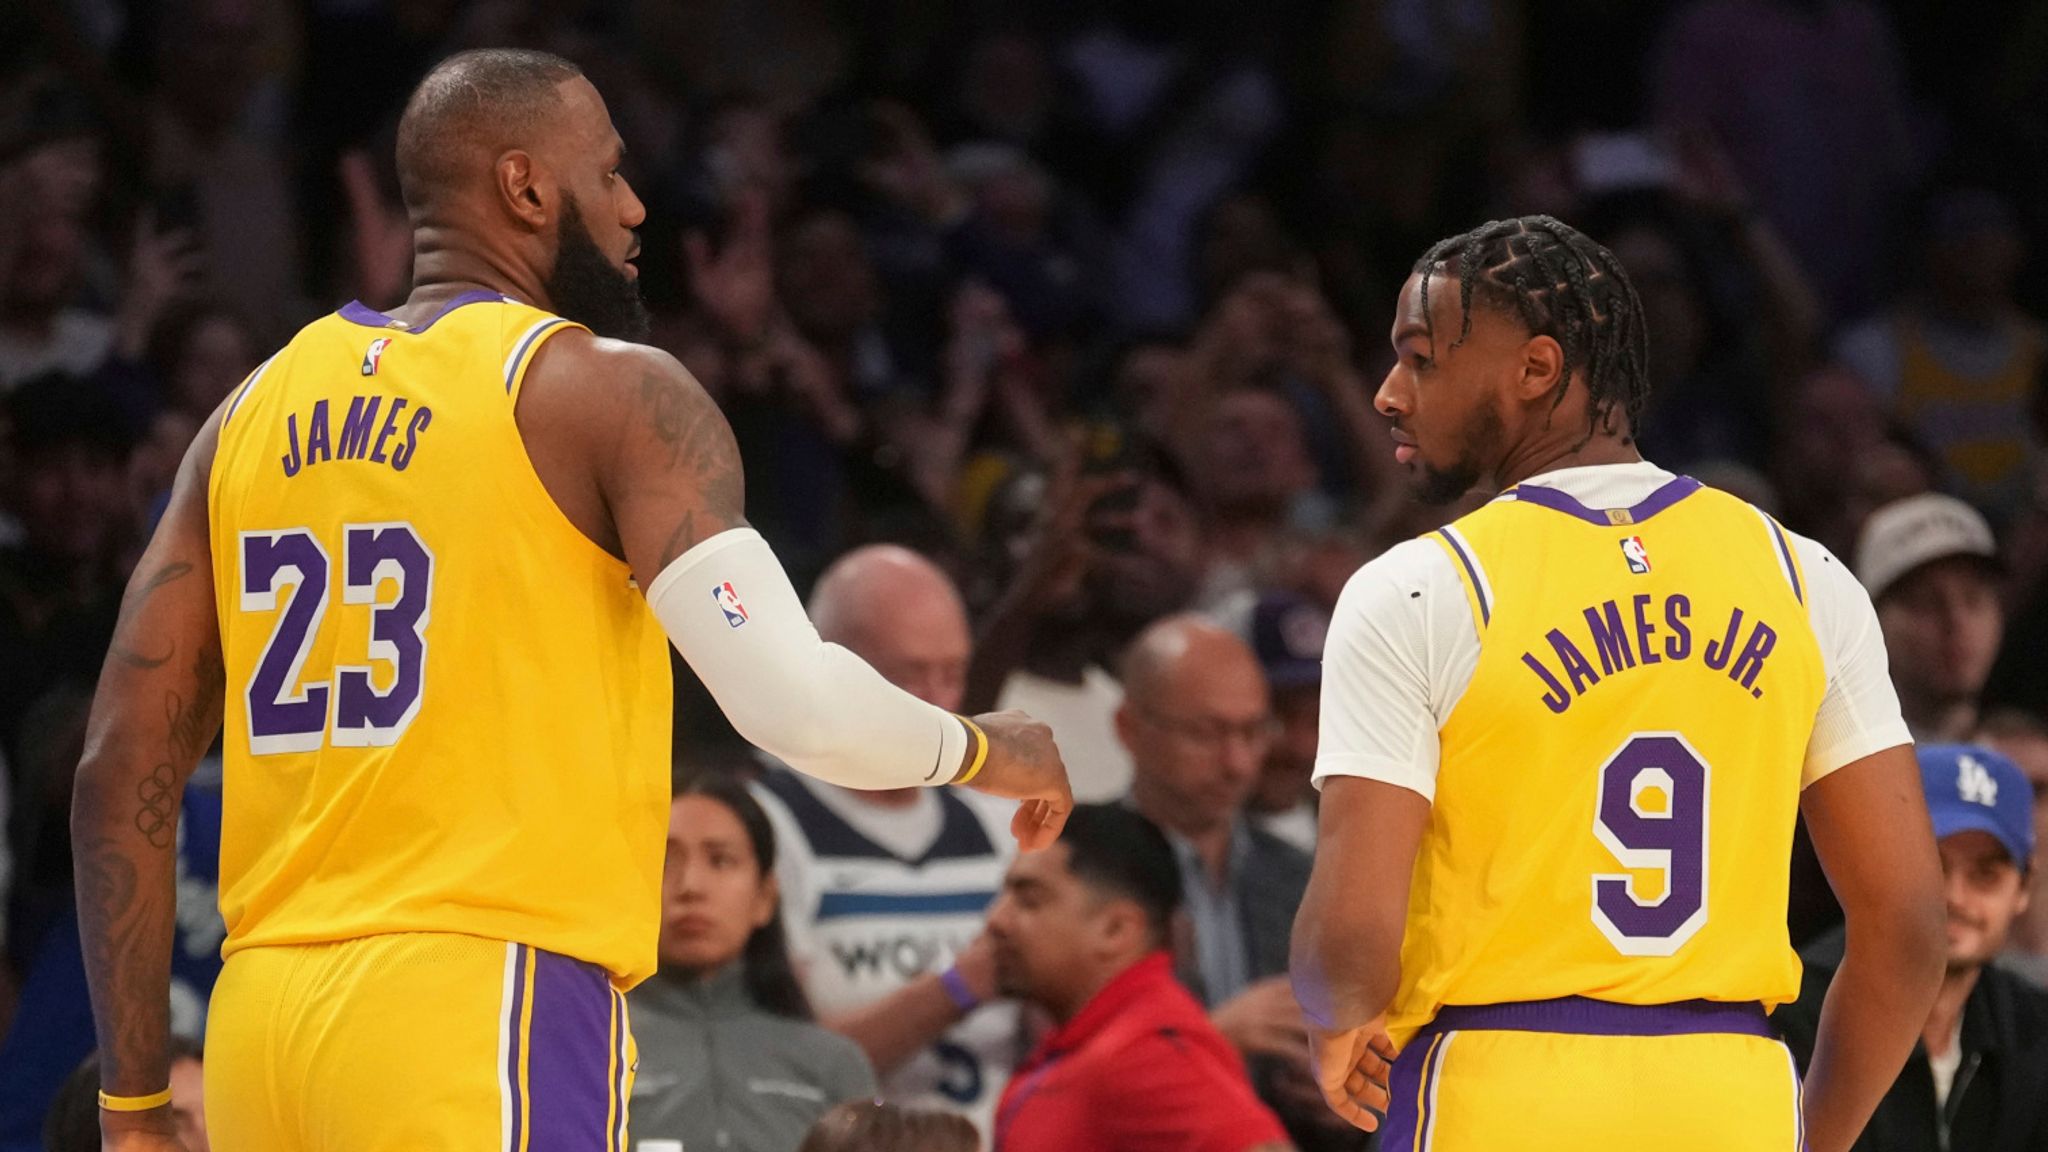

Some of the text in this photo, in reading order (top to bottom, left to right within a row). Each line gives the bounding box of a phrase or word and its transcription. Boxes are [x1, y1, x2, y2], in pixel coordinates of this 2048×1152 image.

[282, 396, 432, 477] JAMES
[239, 521, 435, 756] 23
[1521, 594, 1778, 714] JAMES JR.
[1590, 730, 1712, 957] 9
